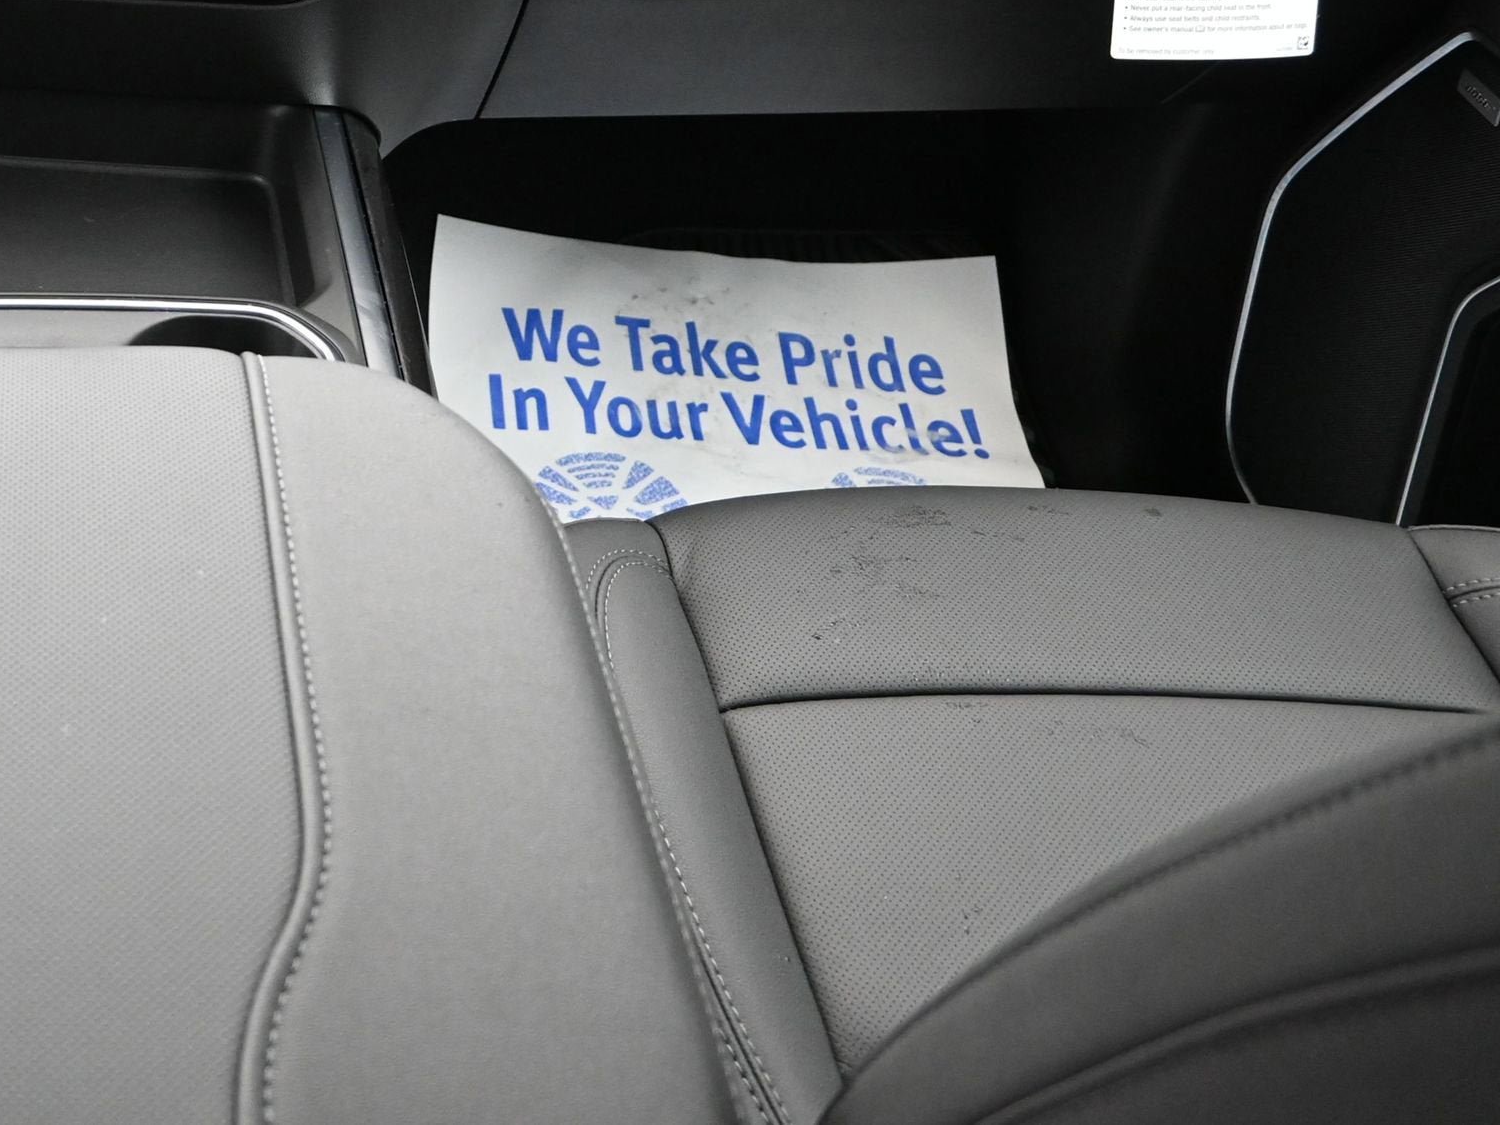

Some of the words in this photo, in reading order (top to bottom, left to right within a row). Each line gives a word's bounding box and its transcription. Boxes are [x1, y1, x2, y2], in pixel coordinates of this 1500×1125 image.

[501, 307, 600, 367] We
[615, 316, 760, 383] Take
[777, 332, 947, 395] Pride
[488, 374, 549, 431] In
[564, 376, 709, 441] Your
[720, 391, 991, 460] Vehicle!
